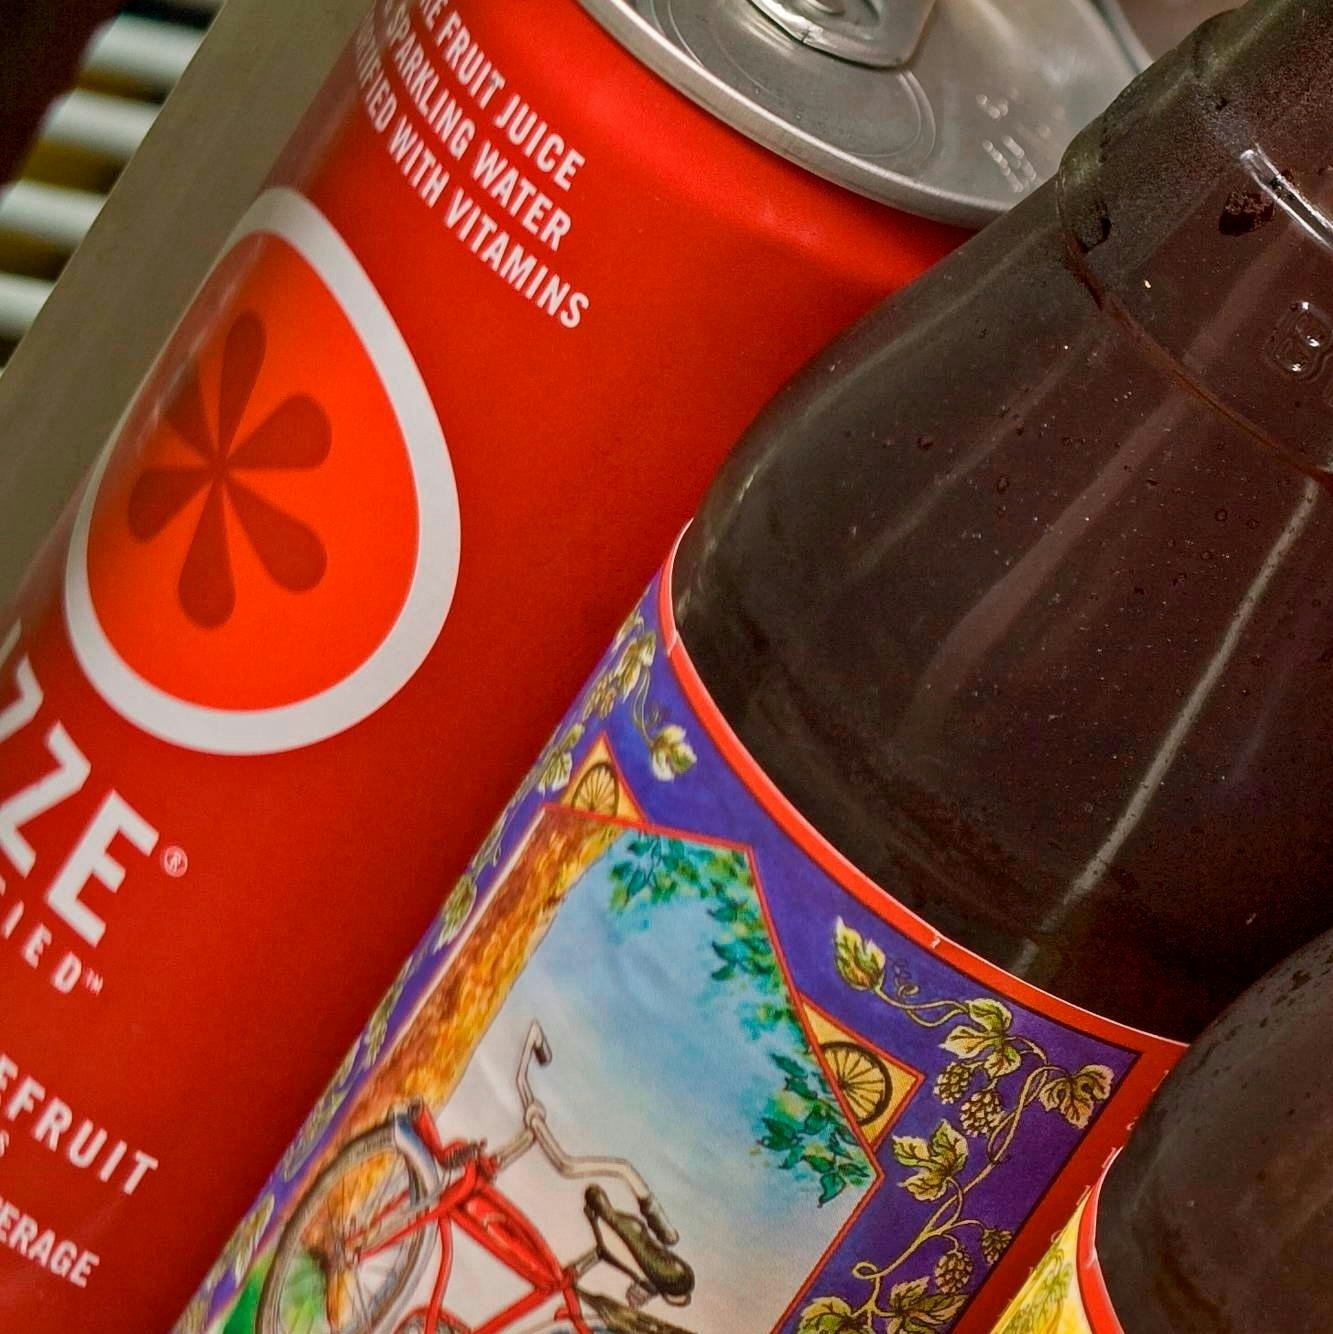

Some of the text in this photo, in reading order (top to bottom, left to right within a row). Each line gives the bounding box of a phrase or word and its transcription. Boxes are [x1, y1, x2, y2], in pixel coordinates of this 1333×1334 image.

[436, 10, 587, 192] FRUIT JUICE
[388, 114, 451, 207] WITH
[442, 186, 591, 329] VITAMINS
[471, 139, 573, 252] WATER
